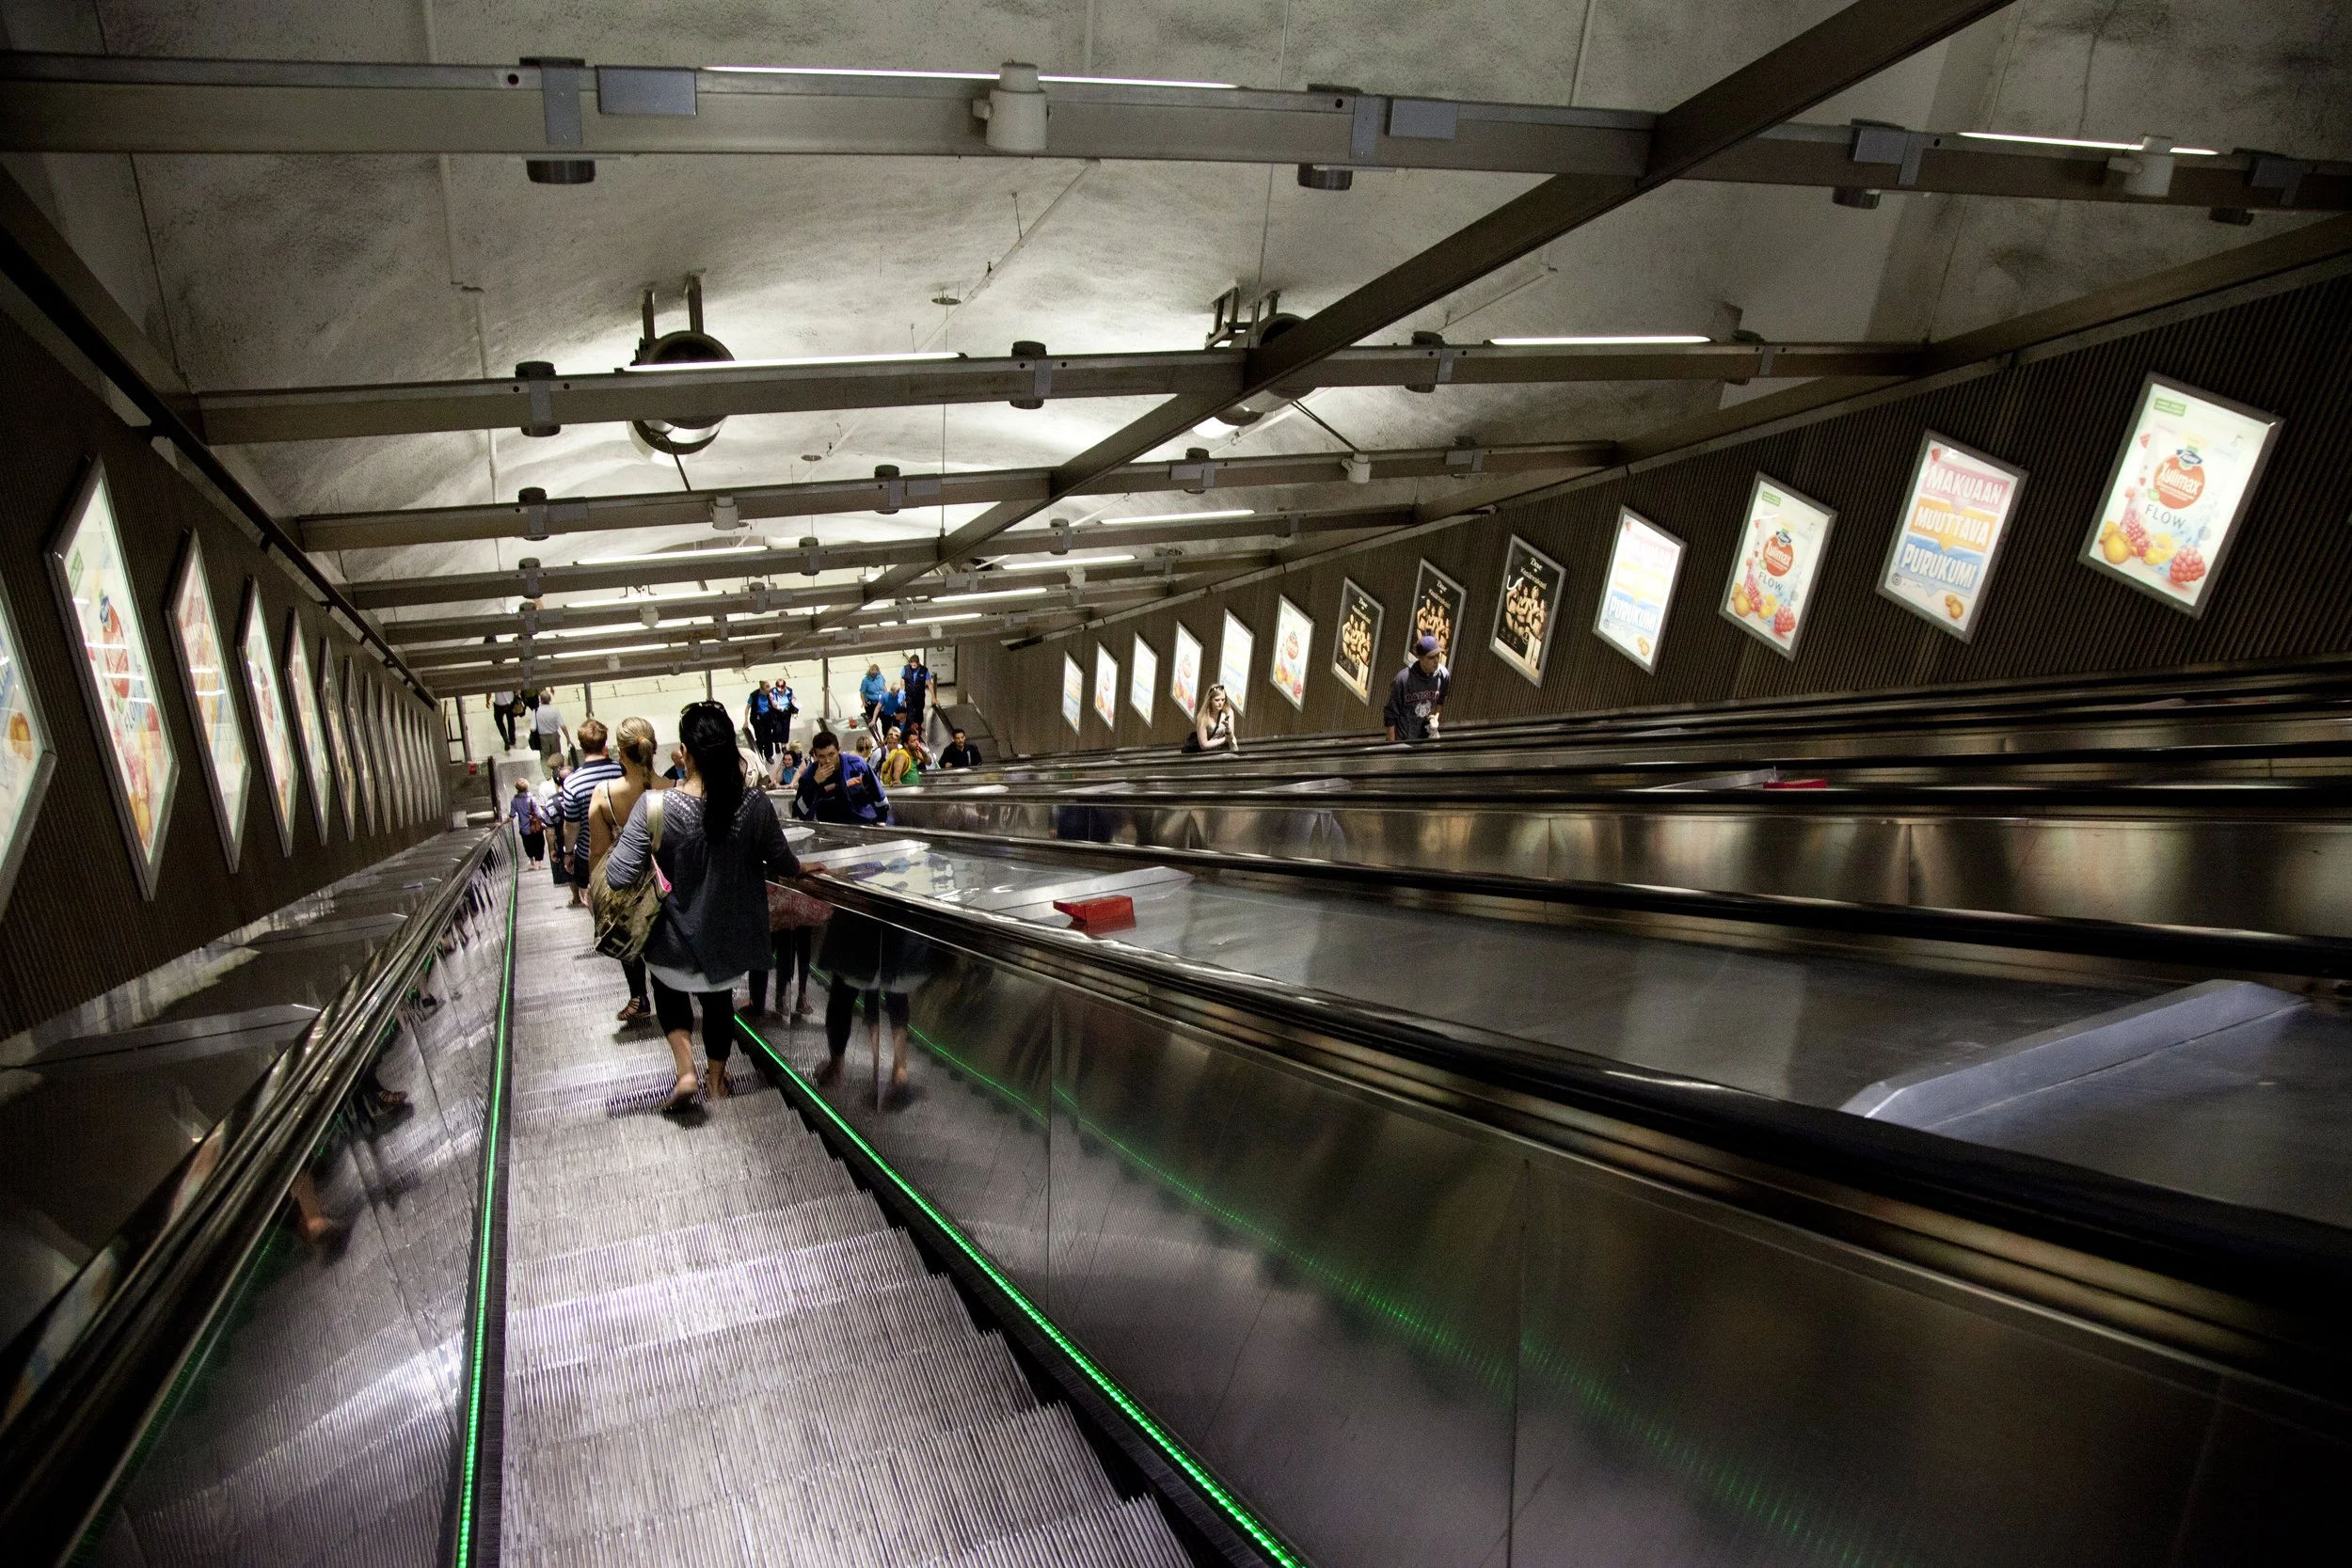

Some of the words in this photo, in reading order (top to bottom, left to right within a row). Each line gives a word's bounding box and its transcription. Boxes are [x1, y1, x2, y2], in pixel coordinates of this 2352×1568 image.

[1927, 465, 2004, 505] MAKUAAN
[1915, 505, 1992, 546] MUUTTAVA
[2145, 504, 2187, 529] FLOW
[1758, 572, 1784, 592] FLOW
[1900, 545, 1979, 589] PURUKUMI
[1609, 596, 1656, 632] PURUKUMI
